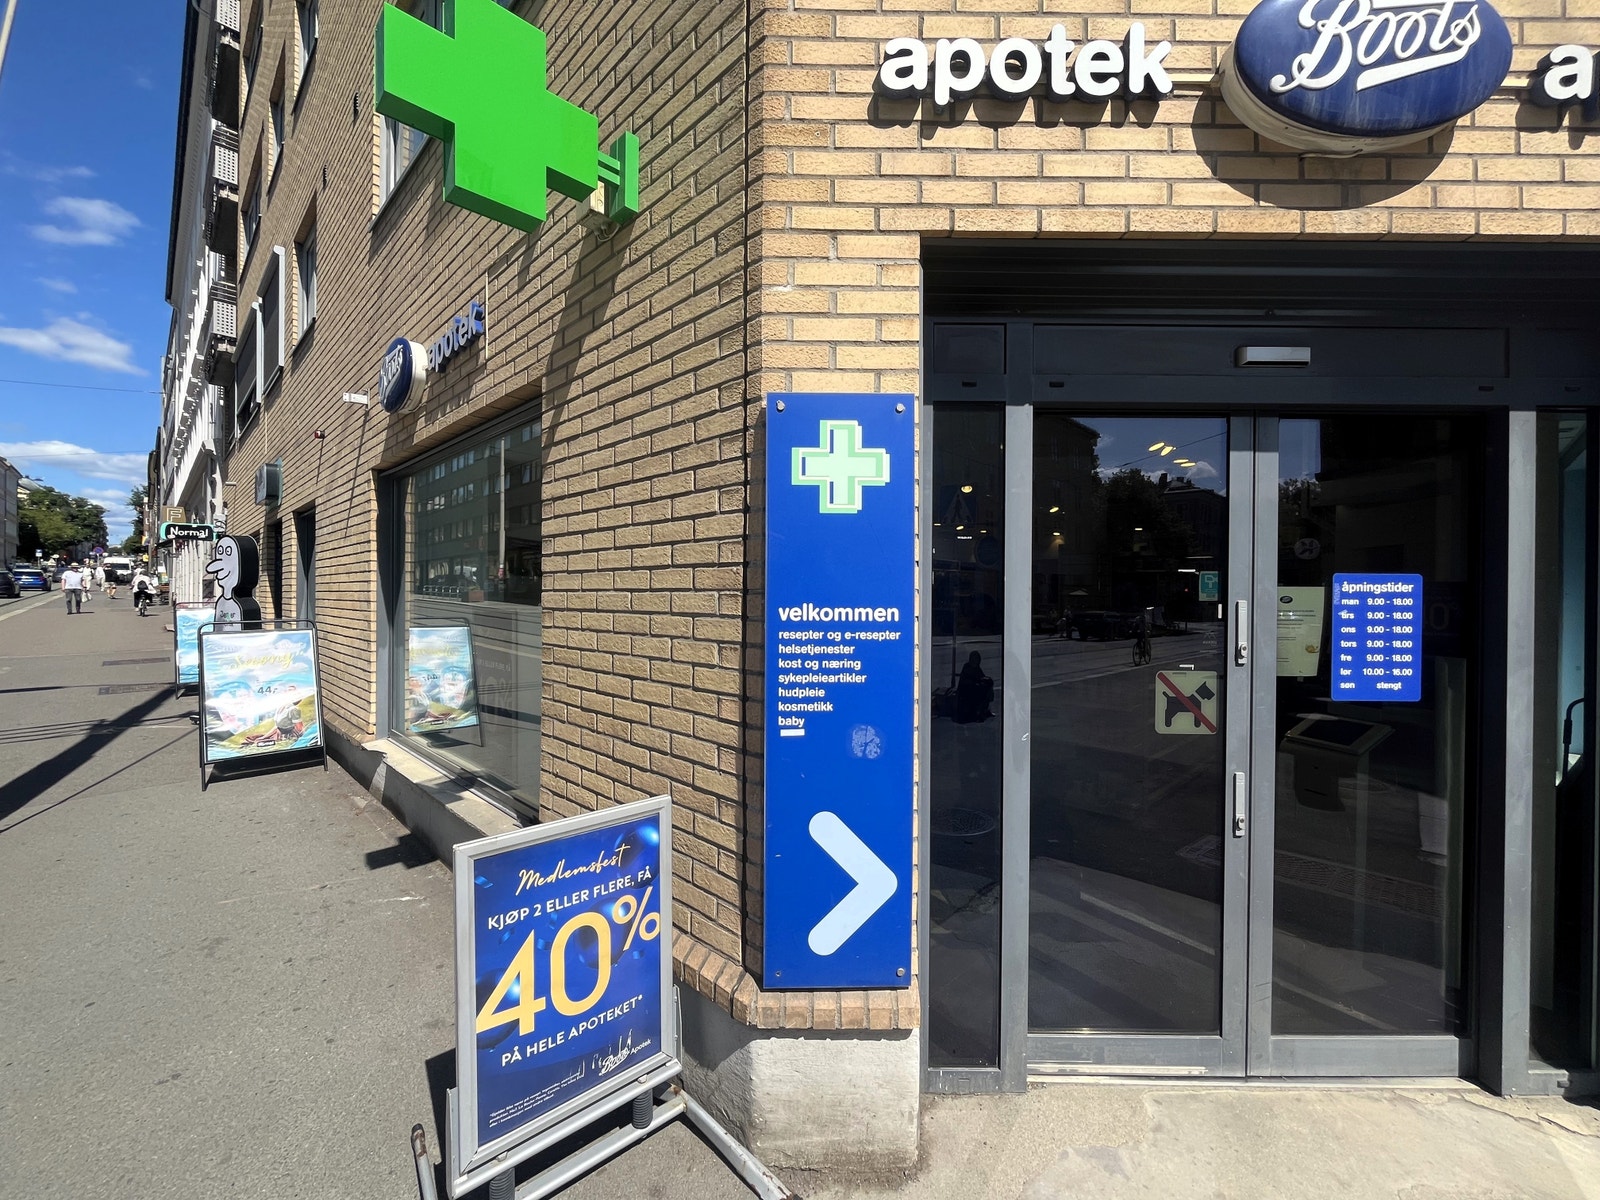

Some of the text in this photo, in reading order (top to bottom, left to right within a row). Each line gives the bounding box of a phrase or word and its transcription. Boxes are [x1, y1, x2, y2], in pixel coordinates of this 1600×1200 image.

[880, 22, 1173, 106] apotek
[1269, 0, 1481, 93] Boots
[428, 301, 484, 373] apotek
[170, 526, 209, 537] Normal
[1342, 581, 1414, 594] åpningstider
[778, 602, 900, 622] velkommen
[778, 630, 901, 641] resepter og e-resepter
[778, 644, 855, 655] helsetjenester
[778, 658, 861, 670] kost og næring
[778, 673, 866, 684] sykepleieartikler
[1377, 682, 1402, 690] stengt
[778, 687, 825, 698] hudpleie
[778, 702, 833, 712] kosmetikk
[778, 716, 805, 727] baby
[515, 843, 631, 896] Medlemsfest
[488, 866, 651, 930] KJØP 2 ELLER FLERE, FÅ
[476, 886, 660, 1036] 40%
[502, 1046, 522, 1067] PÅ
[526, 1032, 565, 1057] HELE
[630, 1038, 651, 1055] Apotek
